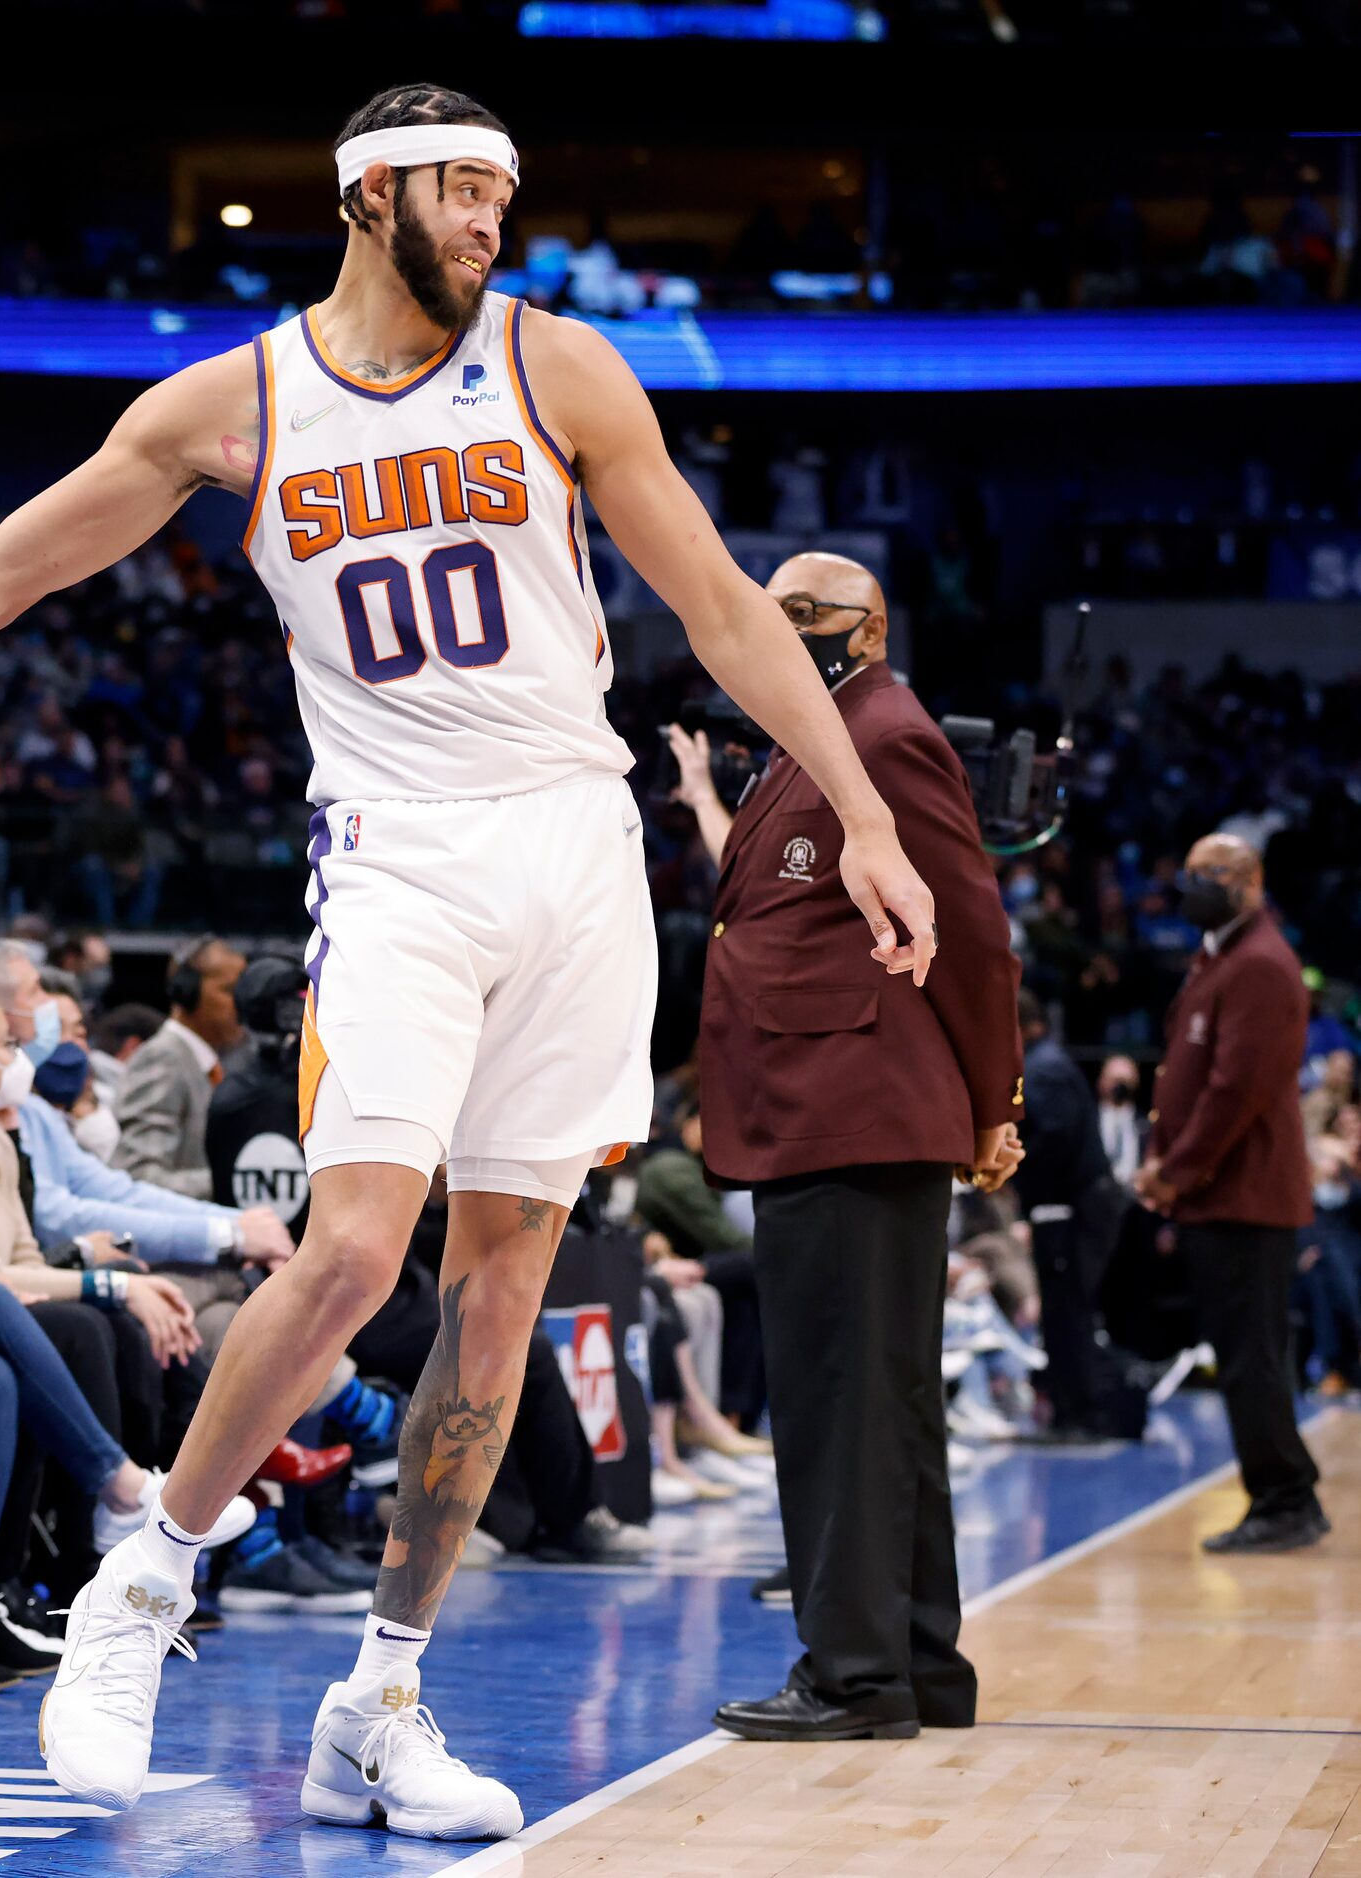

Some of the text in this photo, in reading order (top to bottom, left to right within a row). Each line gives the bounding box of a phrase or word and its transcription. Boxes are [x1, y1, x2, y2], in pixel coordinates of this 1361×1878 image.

[452, 391, 500, 406] PayPal
[335, 539, 510, 686] 00
[233, 1168, 306, 1202] TNT
